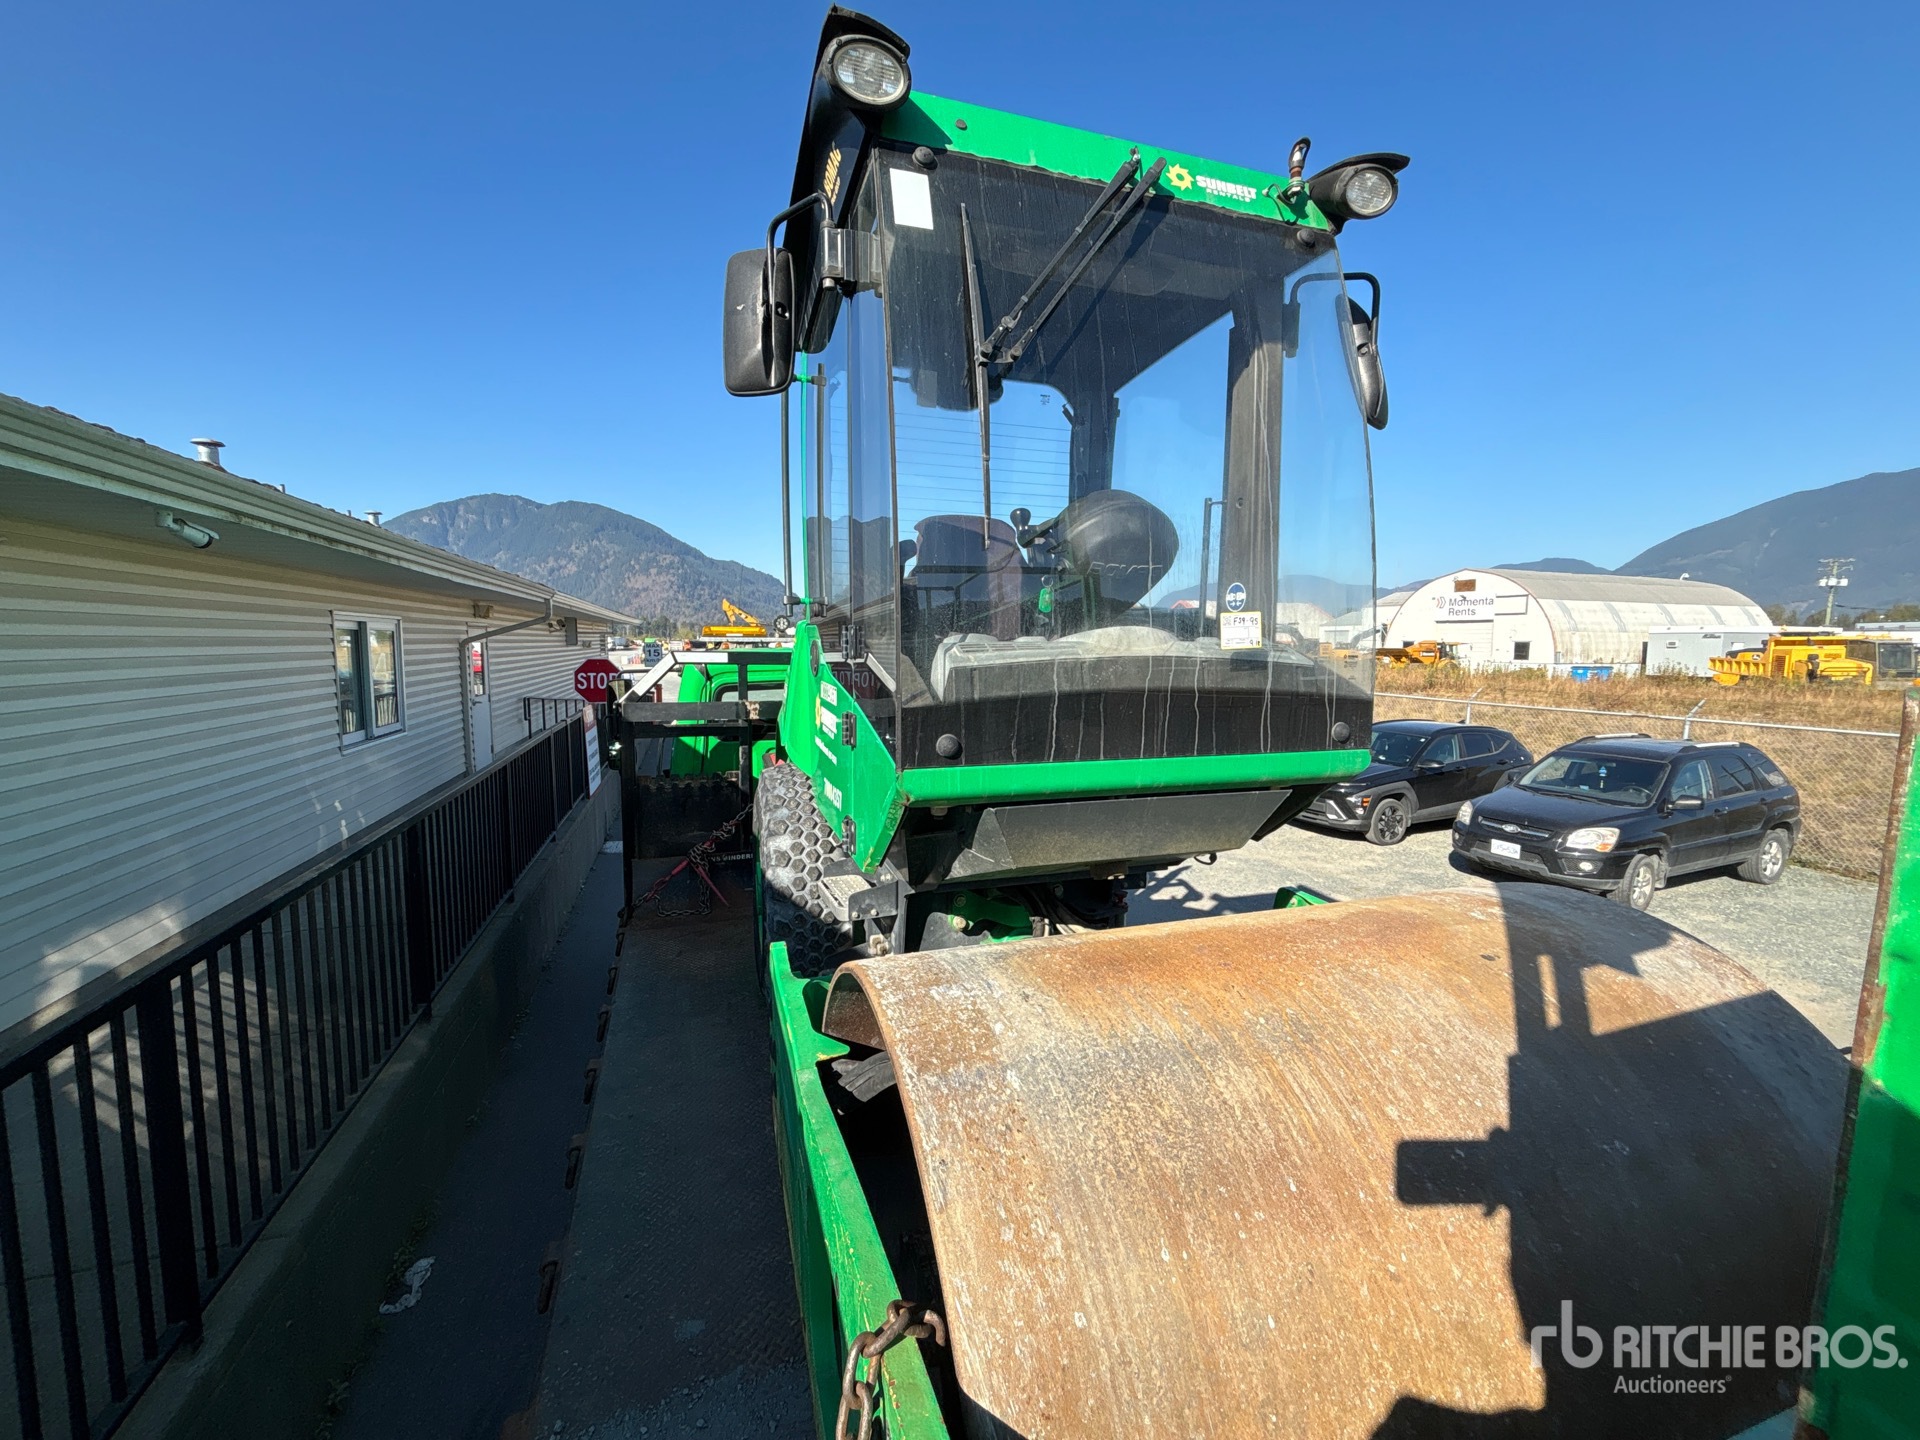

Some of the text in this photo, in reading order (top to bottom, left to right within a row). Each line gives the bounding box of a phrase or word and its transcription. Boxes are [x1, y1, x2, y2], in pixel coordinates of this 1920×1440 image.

[1195, 174, 1257, 200] SUNBELT
[1205, 188, 1251, 203] RENTALS
[1448, 597, 1494, 607] Momenta
[1448, 607, 1477, 616] Rents
[646, 649, 660, 657] 15
